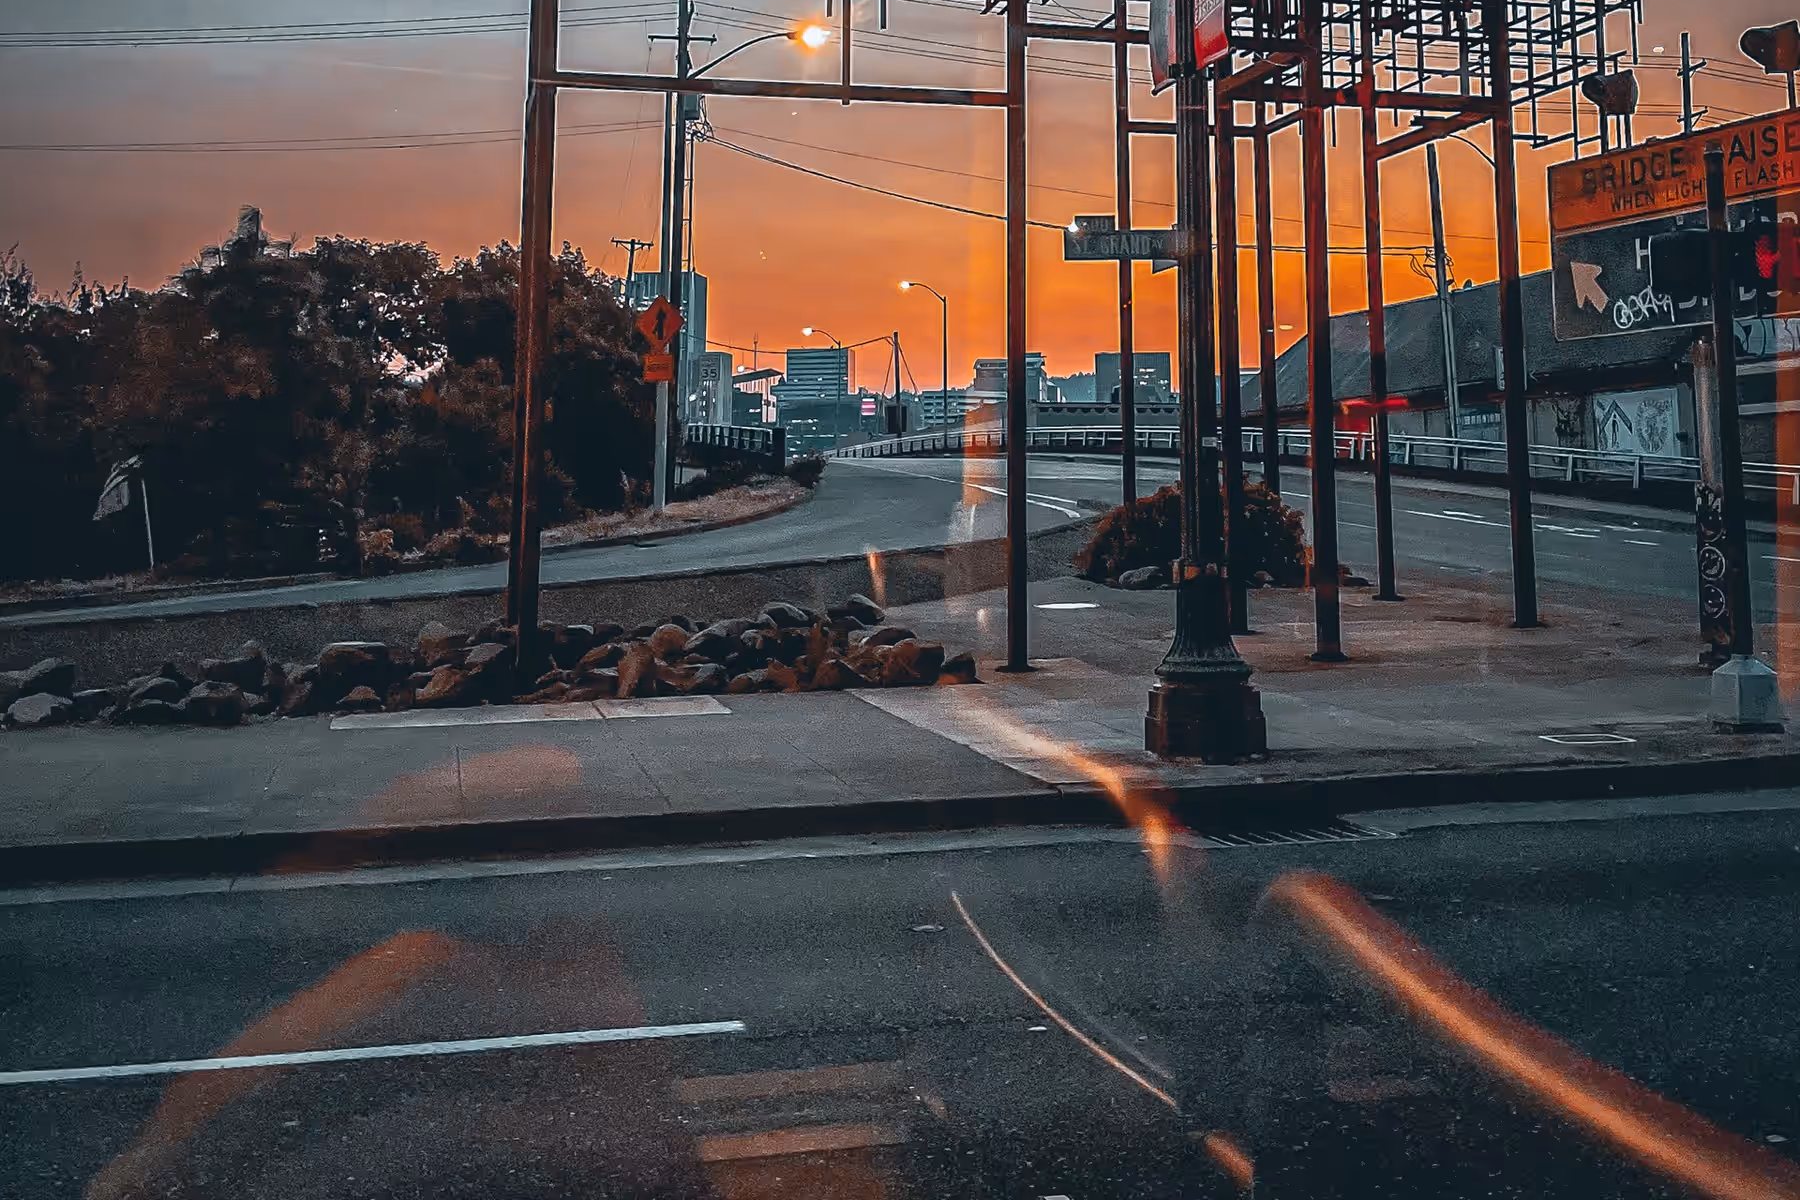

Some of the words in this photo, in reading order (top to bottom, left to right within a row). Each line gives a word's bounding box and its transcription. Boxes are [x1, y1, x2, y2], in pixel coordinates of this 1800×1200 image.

[1582, 146, 1688, 195] BRIDGE
[1727, 122, 1800, 167] AISE
[1610, 189, 1656, 212] WHEN
[1665, 177, 1706, 202] LIGH
[1101, 234, 1151, 256] GRAND
[701, 368, 718, 379] 35
